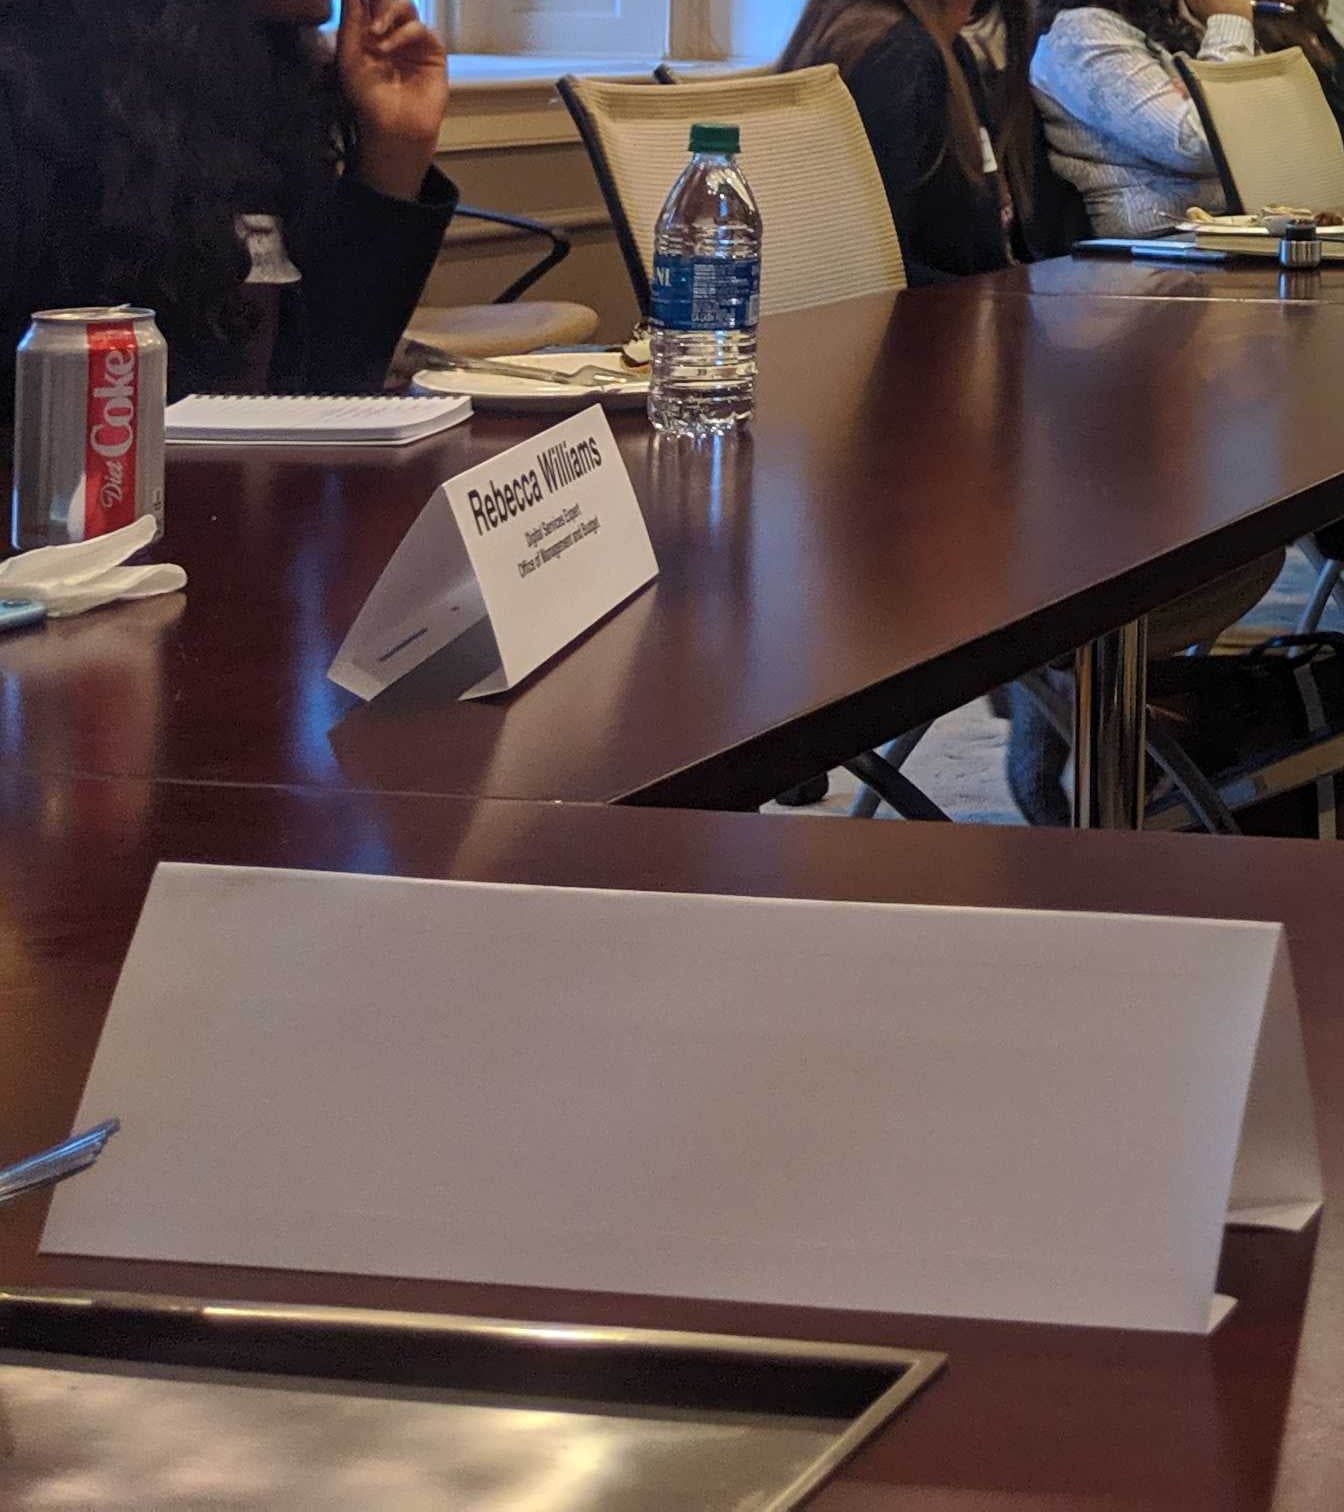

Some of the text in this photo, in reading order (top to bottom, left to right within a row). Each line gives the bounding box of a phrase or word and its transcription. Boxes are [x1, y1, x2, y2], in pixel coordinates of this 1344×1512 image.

[90, 349, 136, 509] Diet Coke
[467, 436, 602, 536] Rebecca Williams
